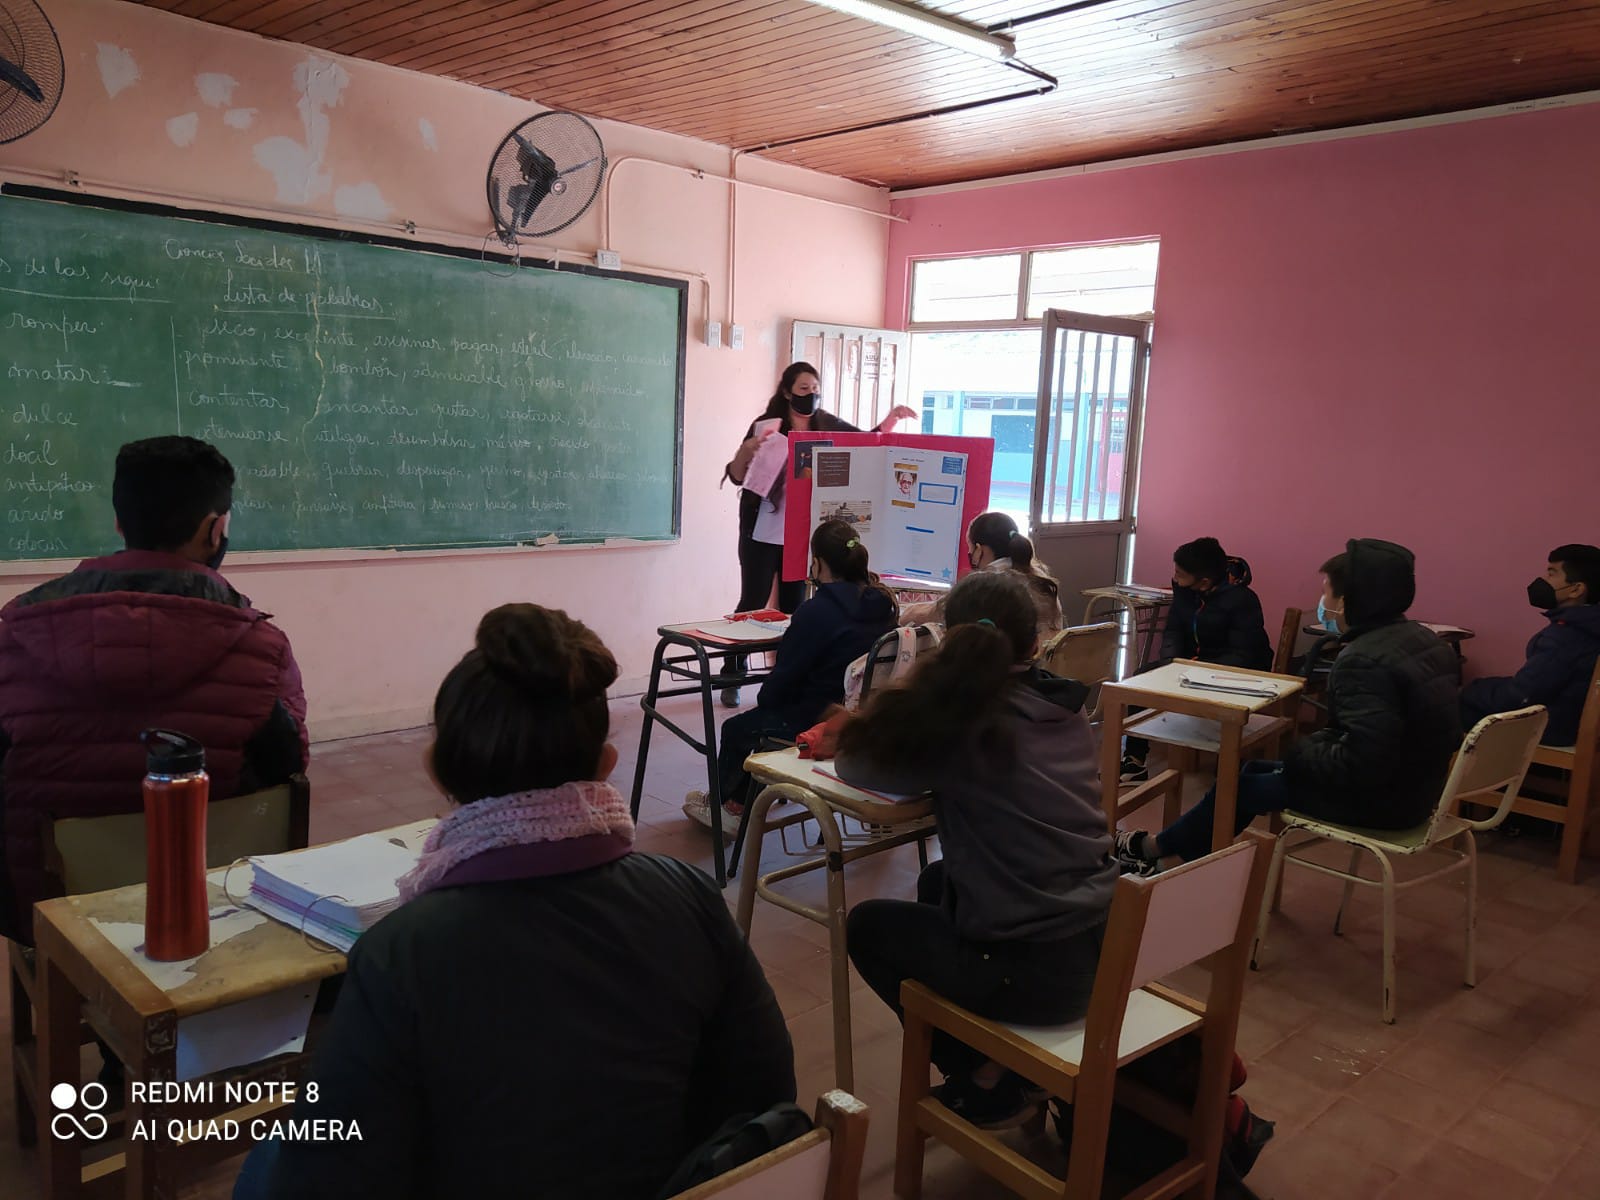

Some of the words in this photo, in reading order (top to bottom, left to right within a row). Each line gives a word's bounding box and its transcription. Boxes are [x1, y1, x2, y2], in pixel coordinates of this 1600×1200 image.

[25, 258, 47, 277] de
[55, 256, 91, 280] las
[224, 268, 269, 304] Lista
[279, 287, 297, 302] de
[13, 403, 78, 425] dulce
[2, 433, 58, 466] dócil
